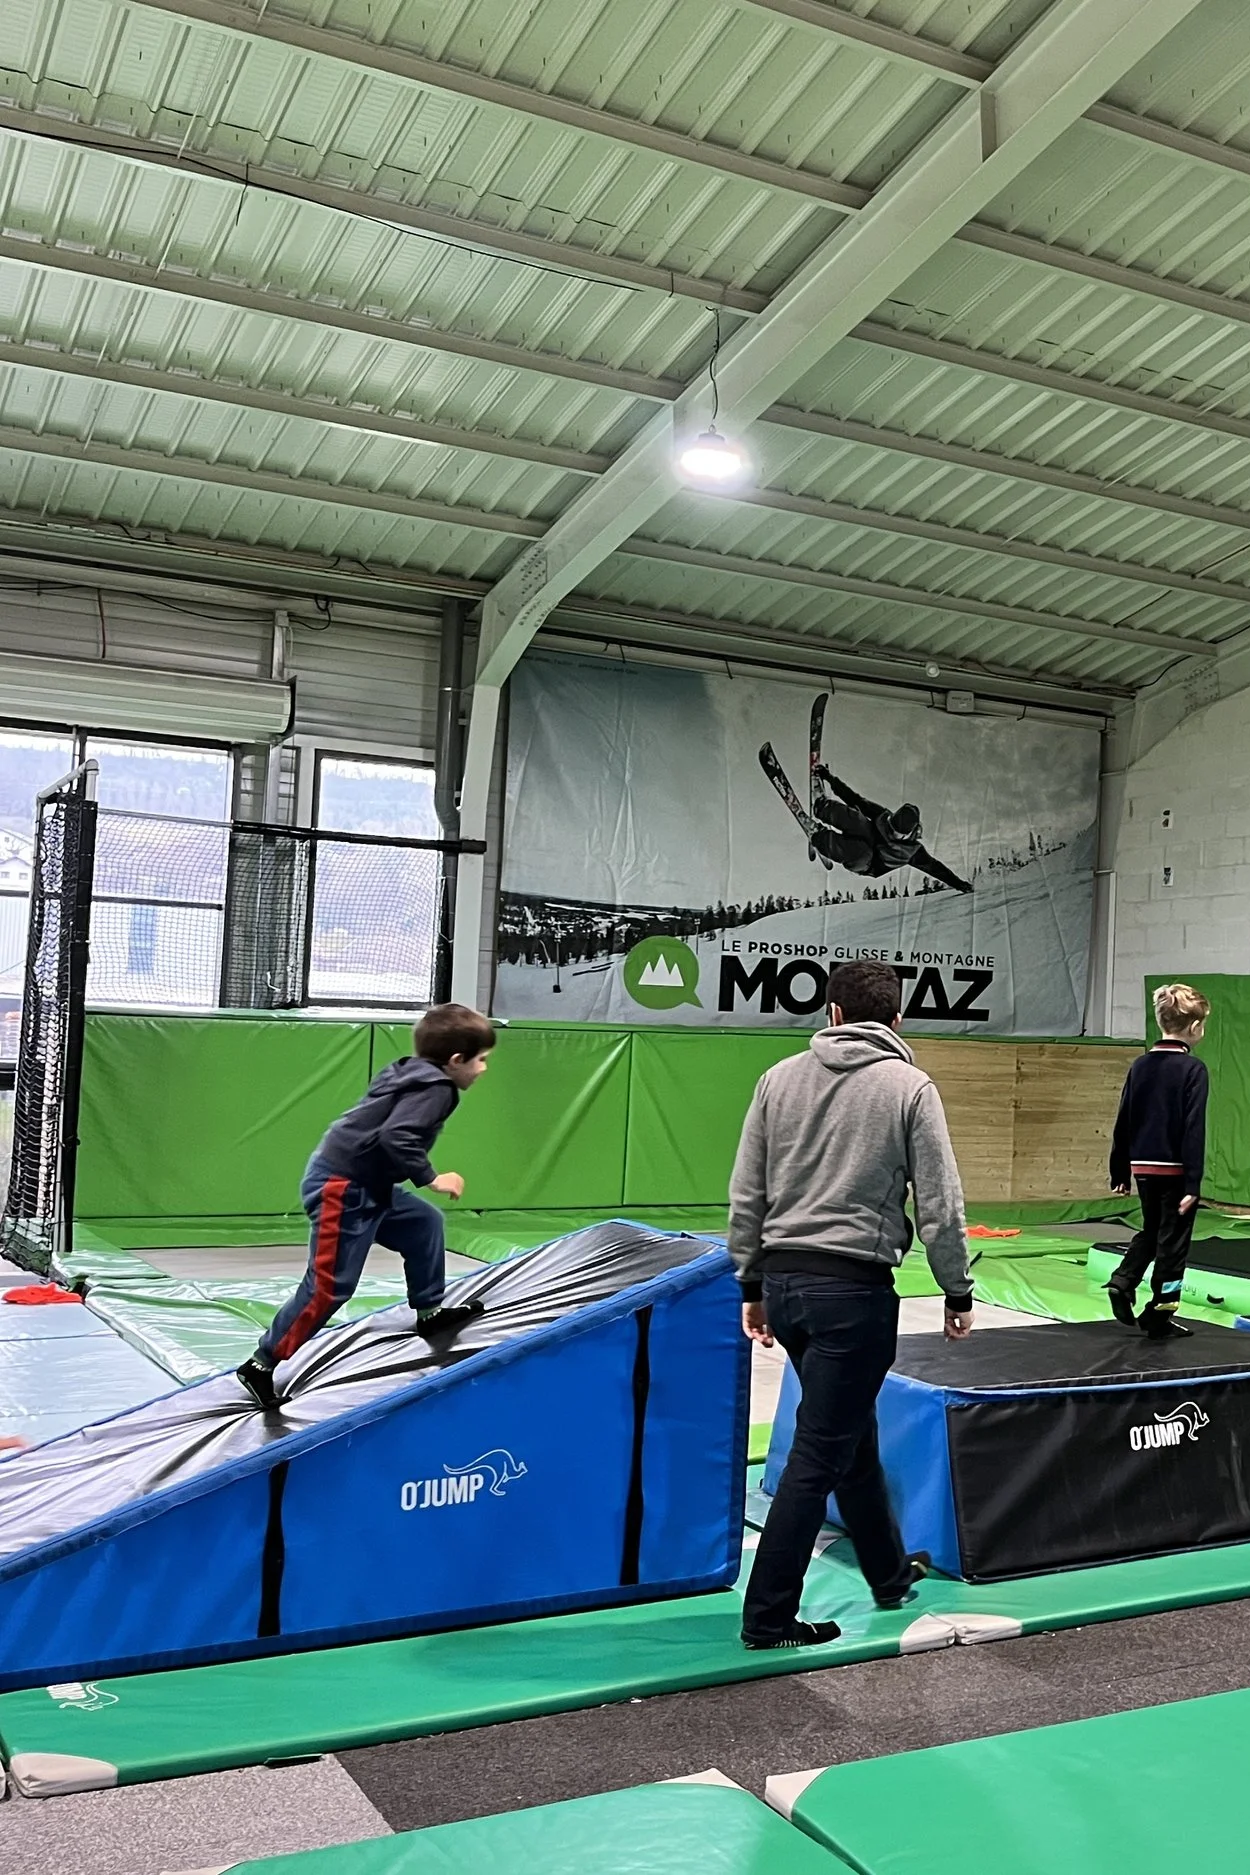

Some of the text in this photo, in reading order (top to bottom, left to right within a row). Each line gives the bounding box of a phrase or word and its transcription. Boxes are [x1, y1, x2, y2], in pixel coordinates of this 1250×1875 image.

[721, 940, 995, 968] LE PROSHOP GLISSE & MONTAGNE
[718, 954, 994, 1022] MOAZ
